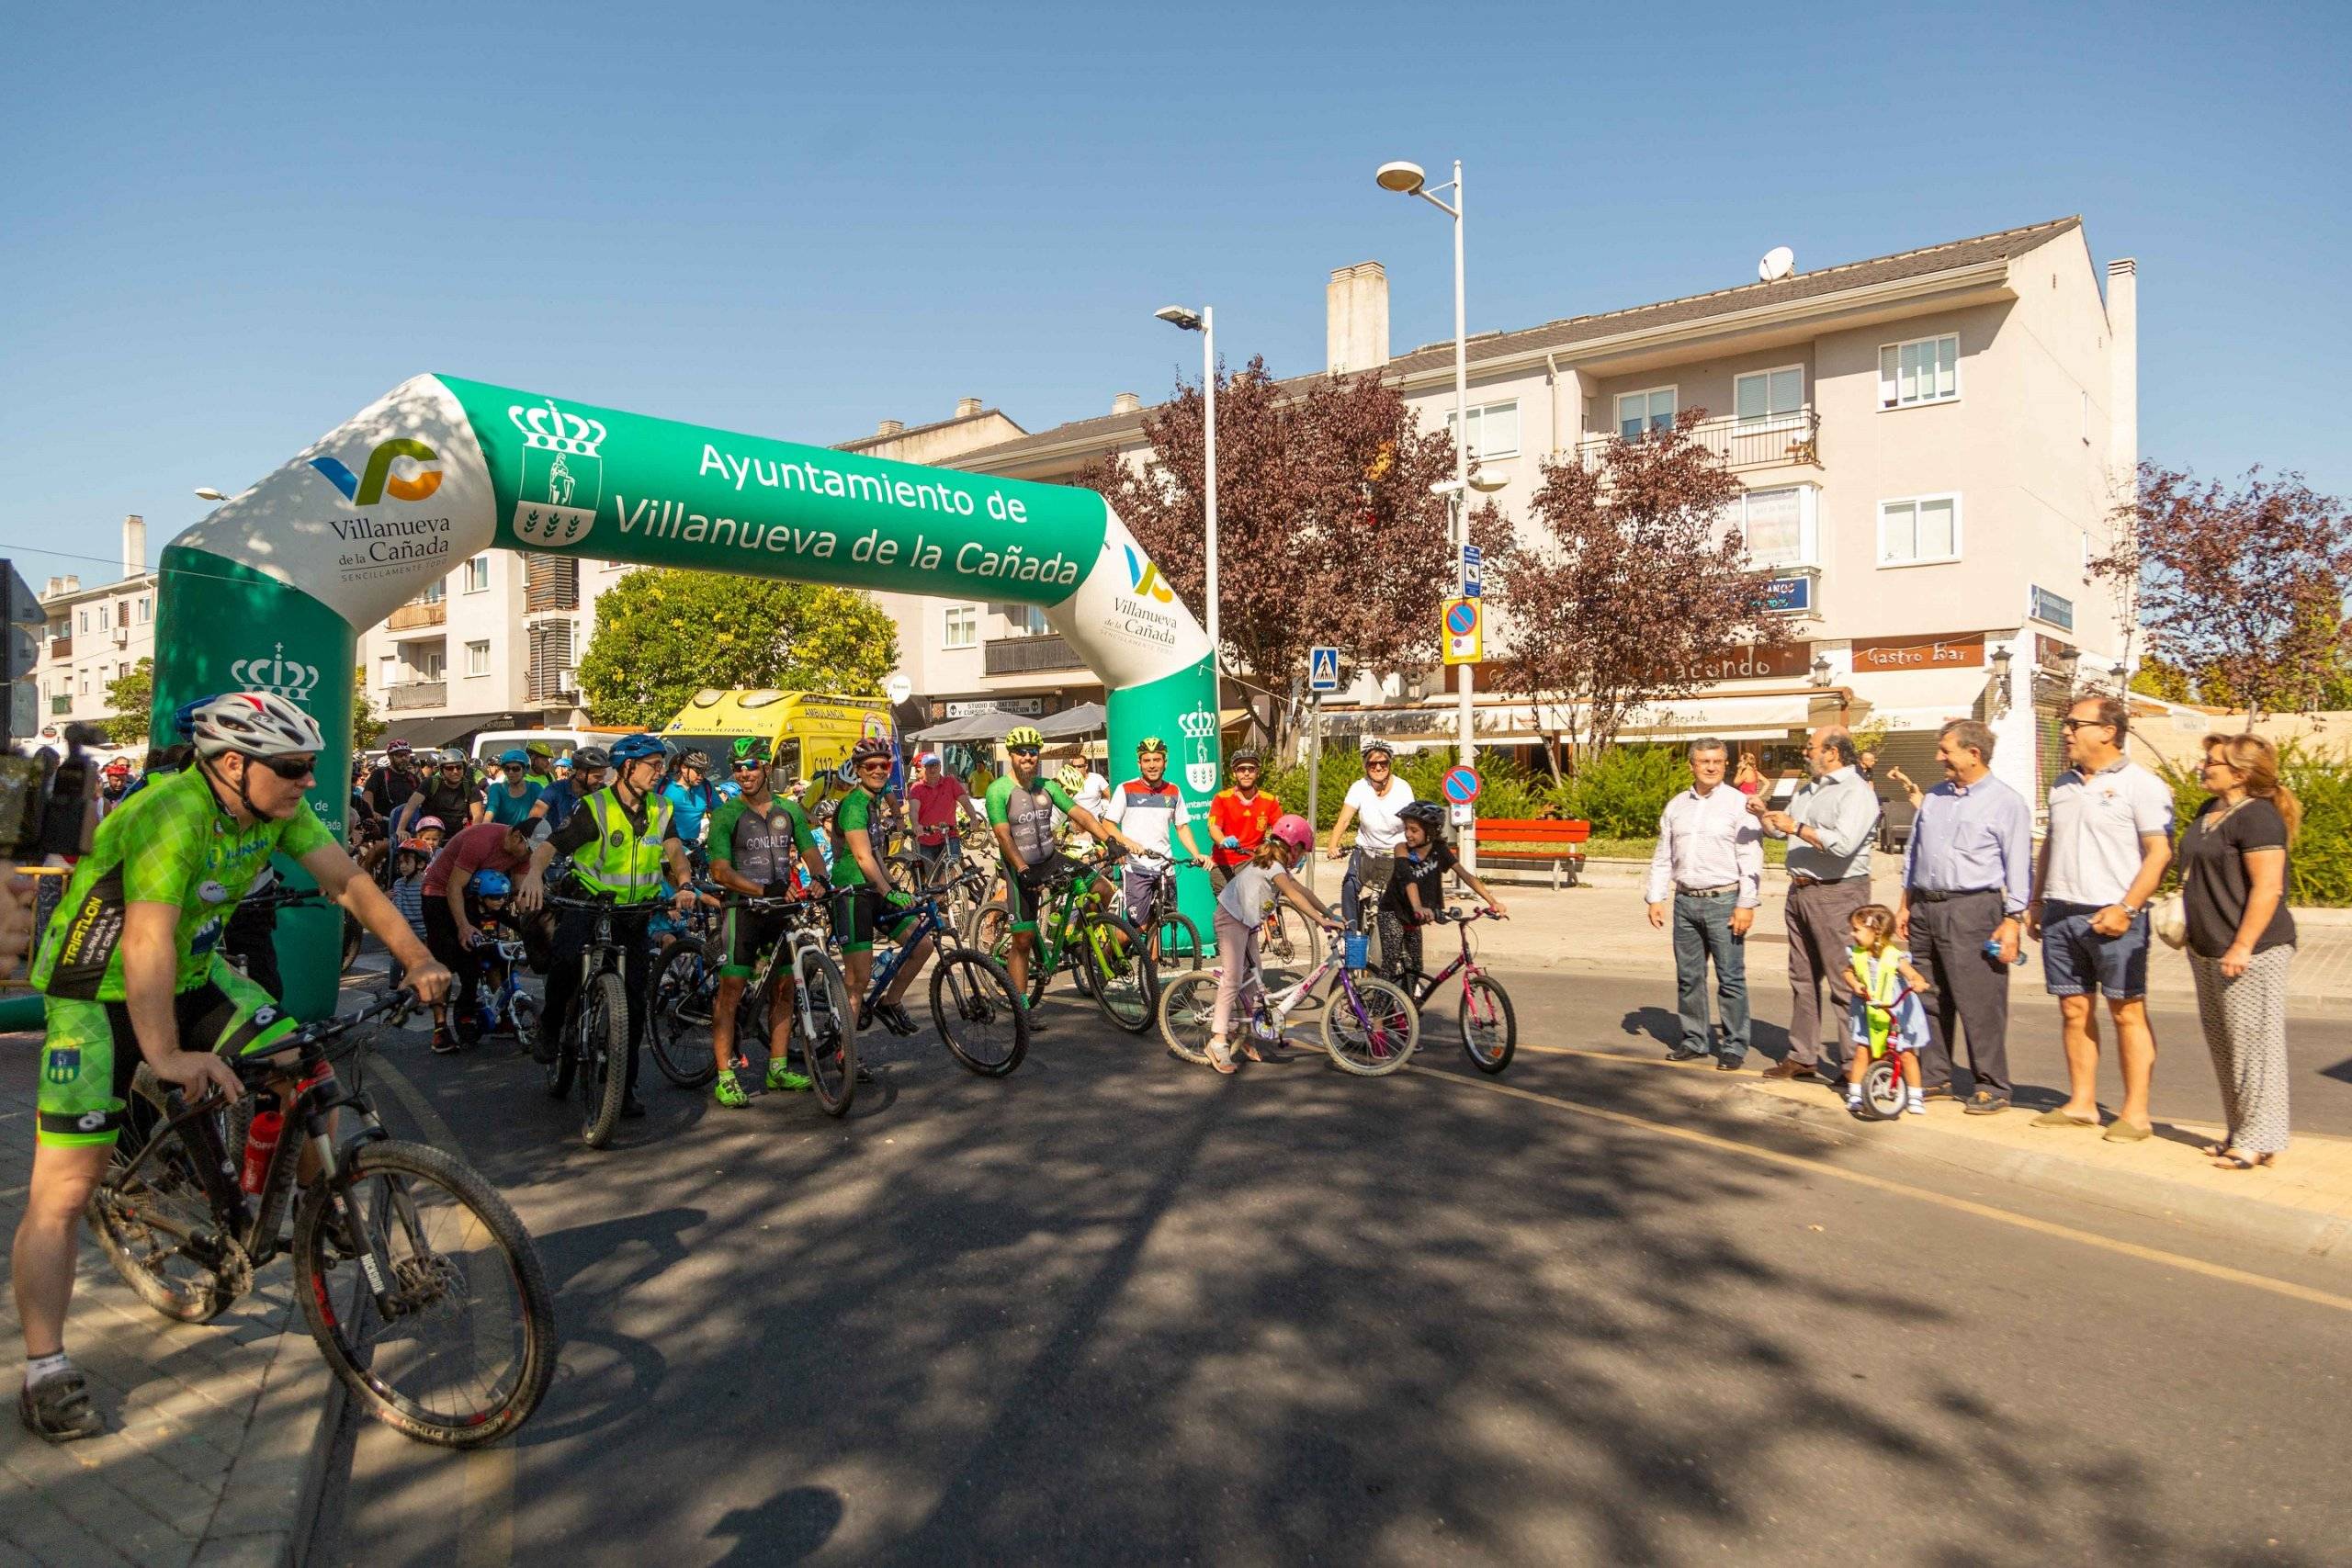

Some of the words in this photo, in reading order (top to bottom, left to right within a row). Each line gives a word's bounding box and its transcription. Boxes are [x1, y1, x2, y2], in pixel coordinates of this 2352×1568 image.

[699, 444, 974, 515] Ayuntamiento
[986, 490, 1027, 524] de
[329, 517, 450, 540] Villanueva
[615, 494, 837, 558] Villanueva
[852, 528, 899, 565] de
[910, 535, 943, 570] la
[956, 542, 1079, 585] Cañada
[338, 554, 354, 566] de
[356, 553, 367, 565] la
[368, 536, 449, 562] Cañada
[1114, 597, 1177, 628] Villanueva
[1125, 618, 1175, 644] Cañada
[1868, 648, 1922, 664] Gastro
[1933, 643, 1967, 660] Bar
[314, 800, 329, 812] de
[1019, 809, 1049, 824] GOMEZ
[63, 897, 103, 965] TRIATLON
